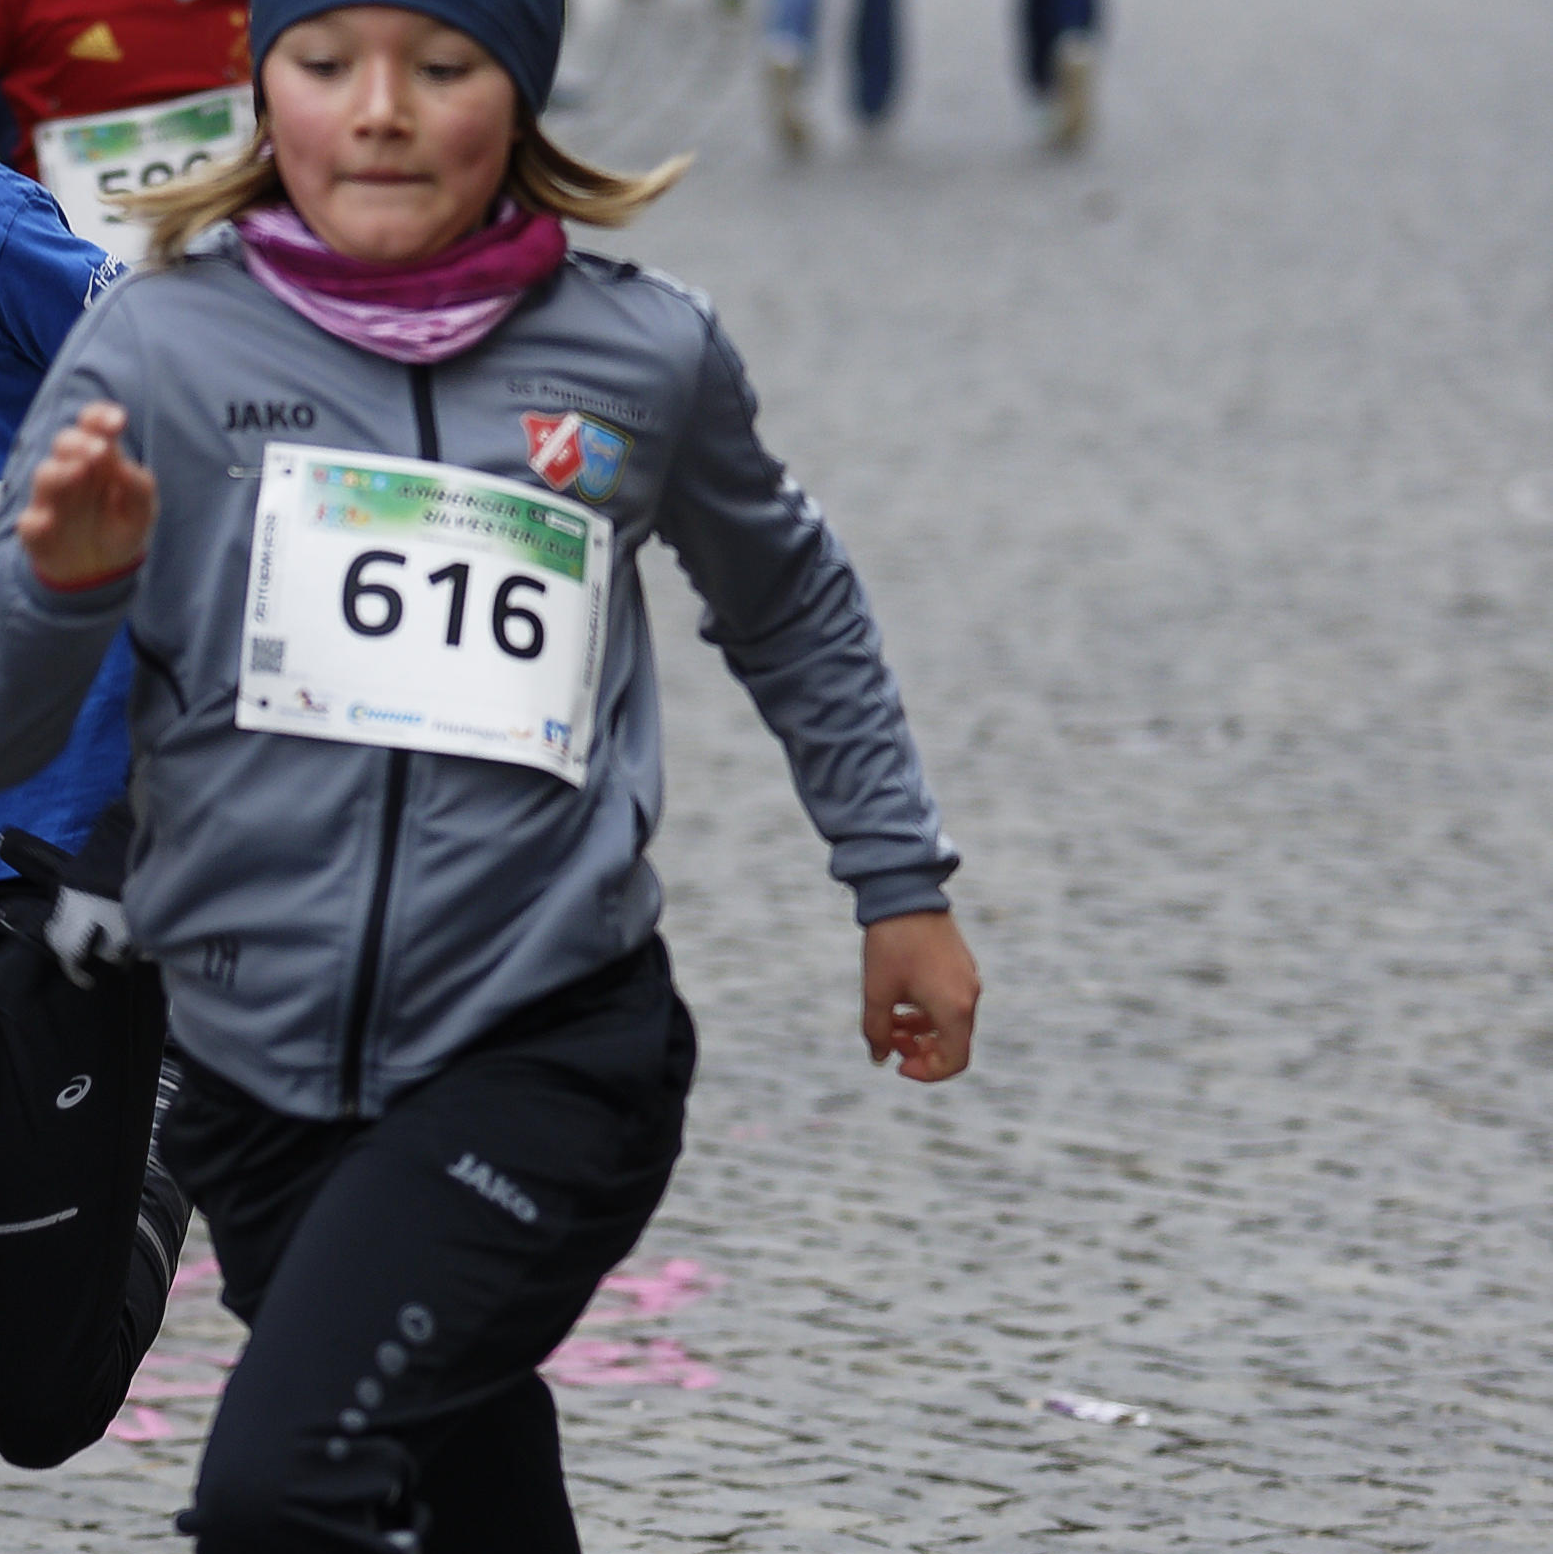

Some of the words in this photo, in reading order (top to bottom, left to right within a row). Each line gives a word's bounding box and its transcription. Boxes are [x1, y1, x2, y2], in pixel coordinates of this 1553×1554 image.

[224, 400, 314, 431] JAKO
[343, 550, 546, 660] 616
[446, 1152, 538, 1223] JAKO
